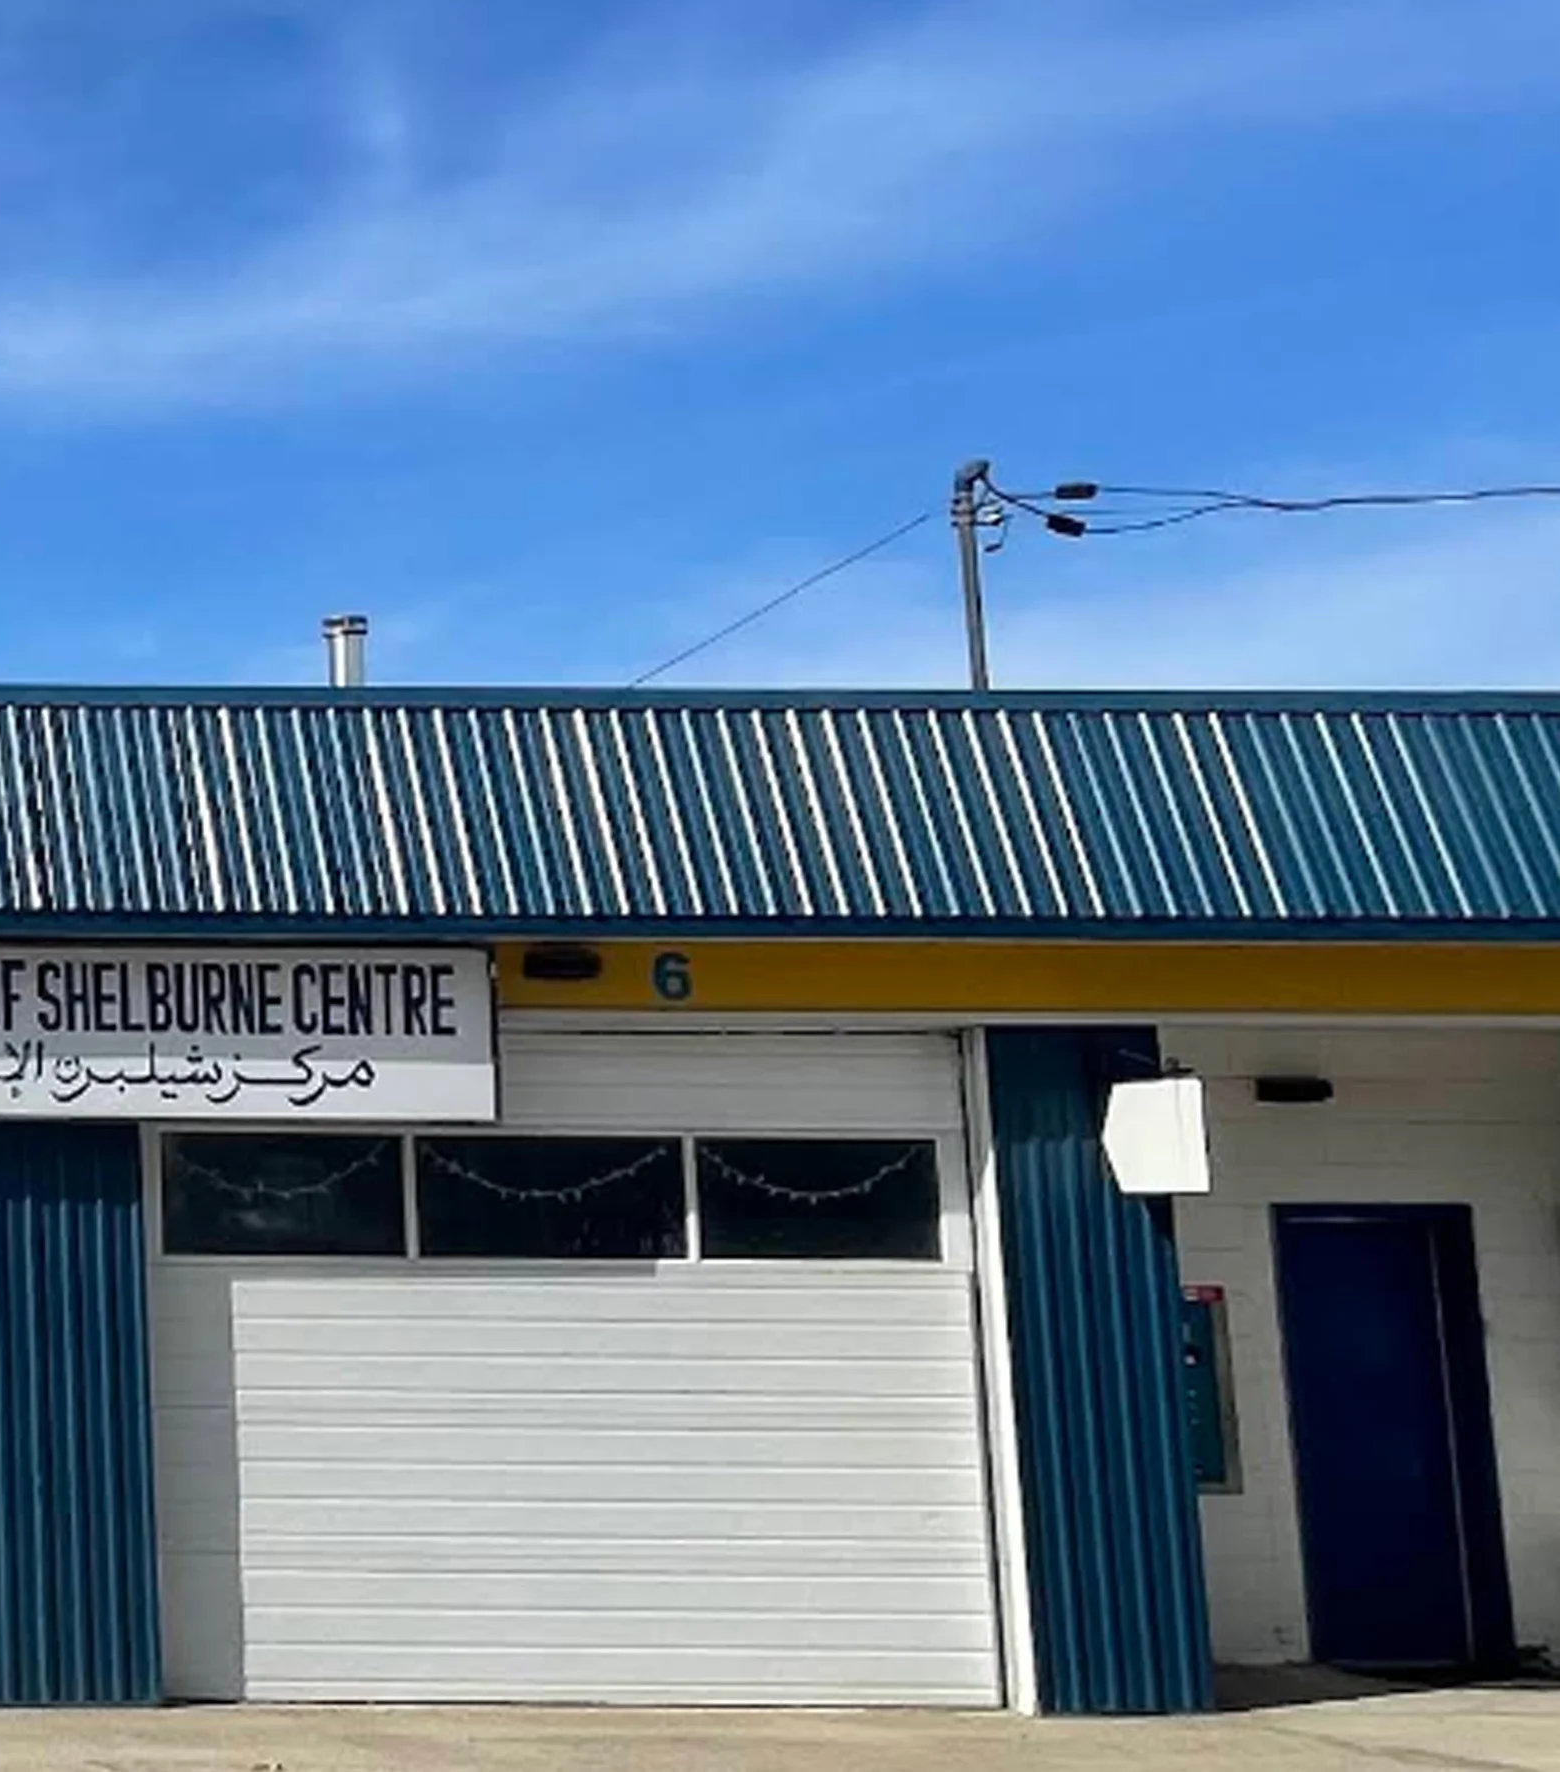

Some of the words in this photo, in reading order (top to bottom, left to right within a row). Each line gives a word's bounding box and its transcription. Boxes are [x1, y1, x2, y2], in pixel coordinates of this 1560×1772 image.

[37, 960, 284, 1034] SHELBURNE
[292, 963, 458, 1036] CENTRE
[654, 952, 691, 1001] 6
[51, 1042, 223, 1102] شيلبرن
[206, 1045, 376, 1106] مركز
